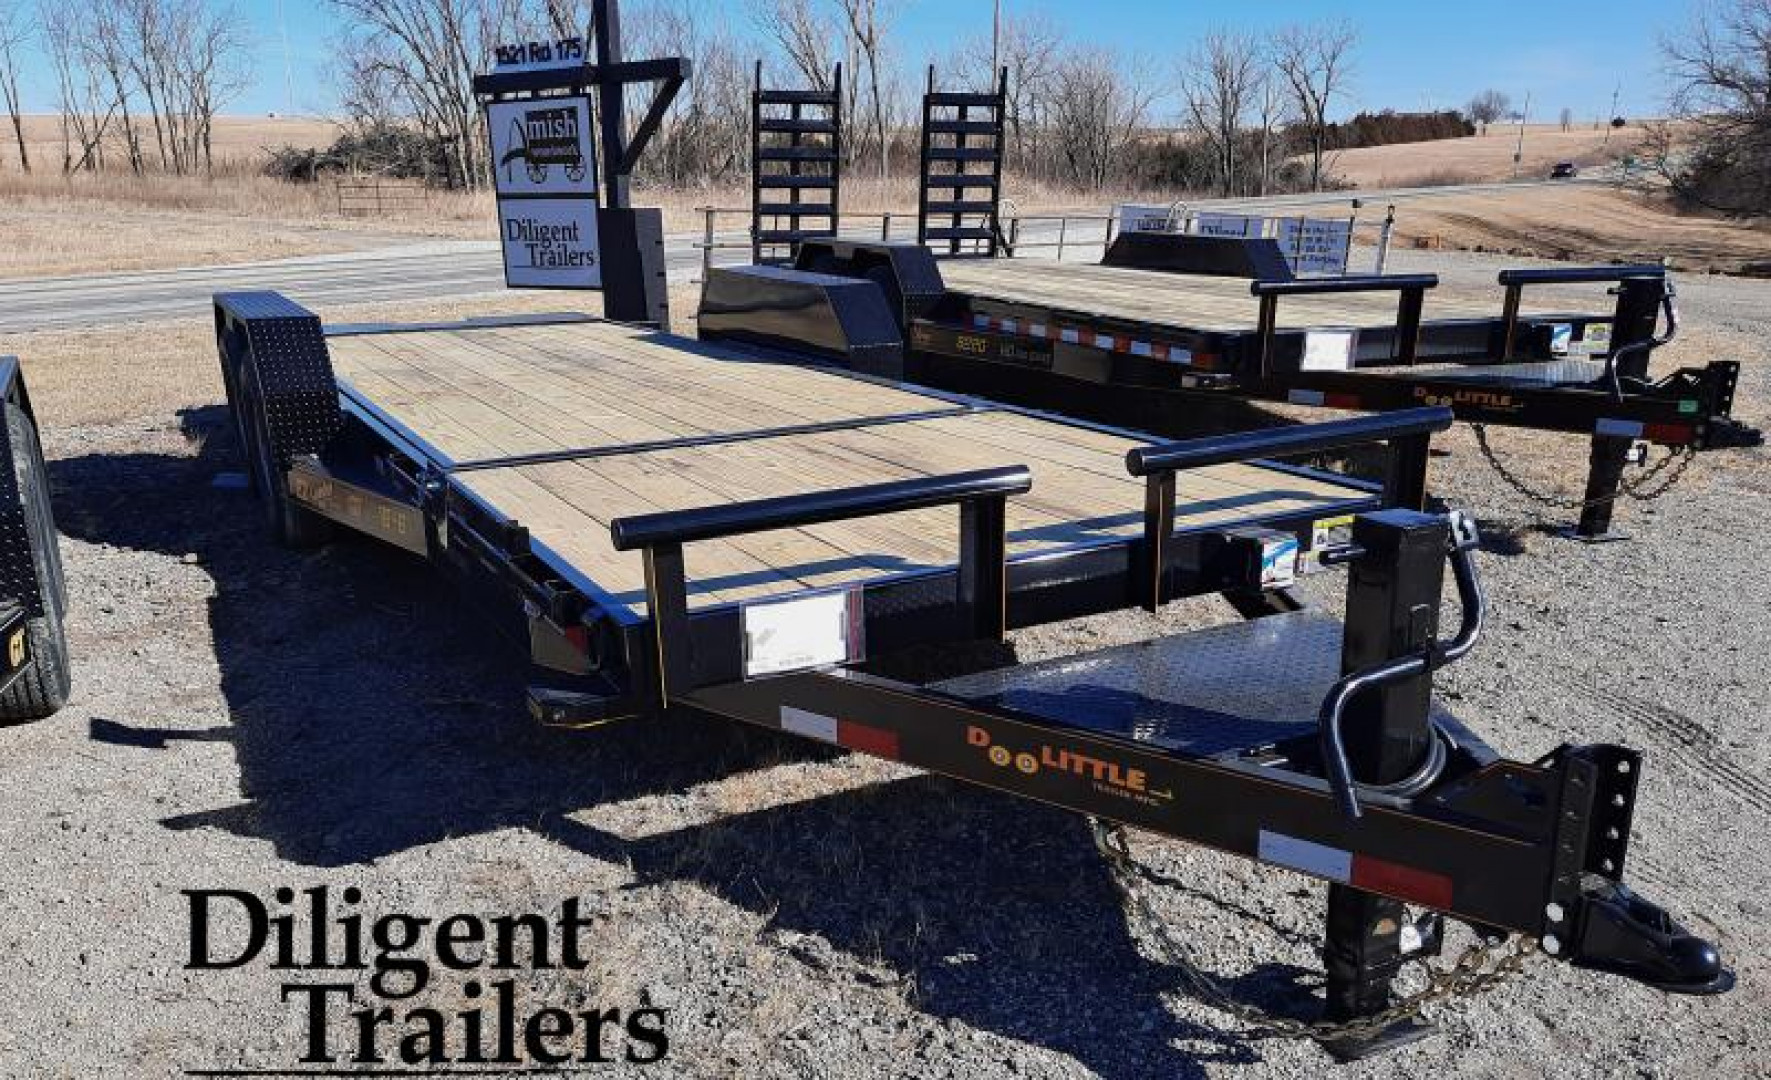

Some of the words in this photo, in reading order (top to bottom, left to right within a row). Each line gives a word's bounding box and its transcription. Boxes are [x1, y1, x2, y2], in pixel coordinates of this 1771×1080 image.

[529, 40, 551, 63] Rd
[556, 37, 581, 61] 175
[506, 218, 579, 249] Diligent
[525, 242, 594, 267] Trailers
[967, 725, 1147, 791] DOOLITTLE
